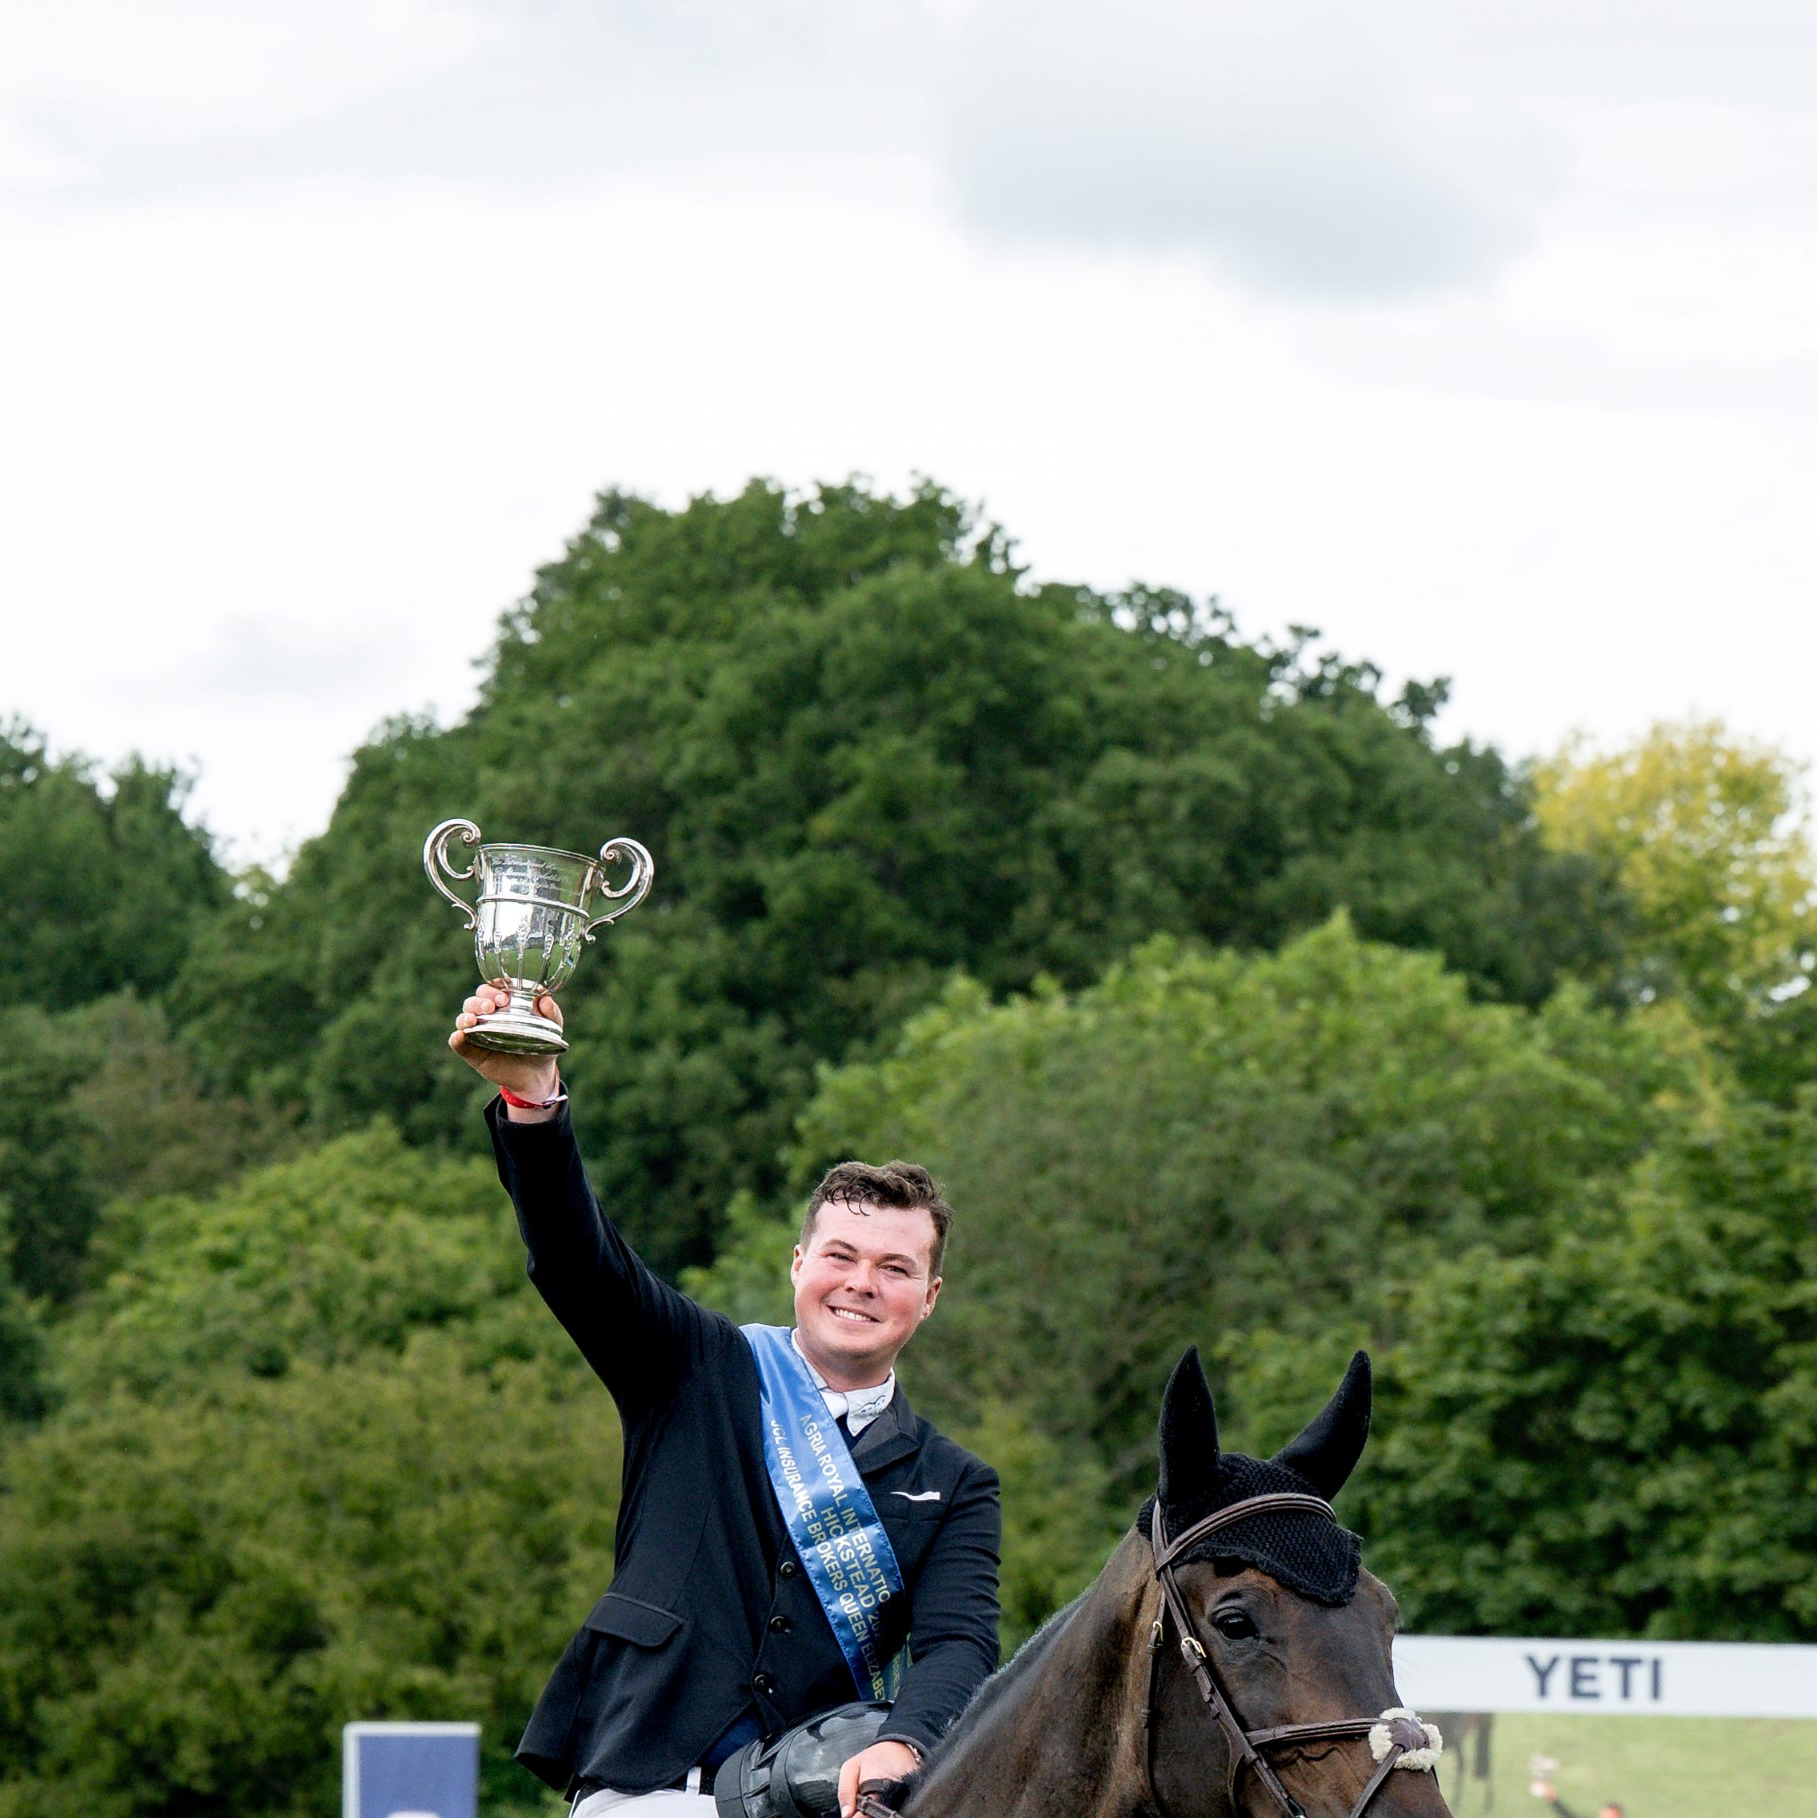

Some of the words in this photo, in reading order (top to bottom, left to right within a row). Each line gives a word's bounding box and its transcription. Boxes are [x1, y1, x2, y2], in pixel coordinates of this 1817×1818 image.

[770, 1419, 788, 1445] JCL
[777, 1446, 818, 1523] INSURANCE
[799, 1413, 827, 1457] AGRIA
[817, 1452, 849, 1508] ROYAL
[840, 1506, 891, 1604] INTERNATIO
[807, 1520, 849, 1592] BROKERS
[820, 1506, 876, 1609] HICKSTEAD
[839, 1591, 871, 1643] QUEEN
[1525, 1655, 1663, 1701] YETI
